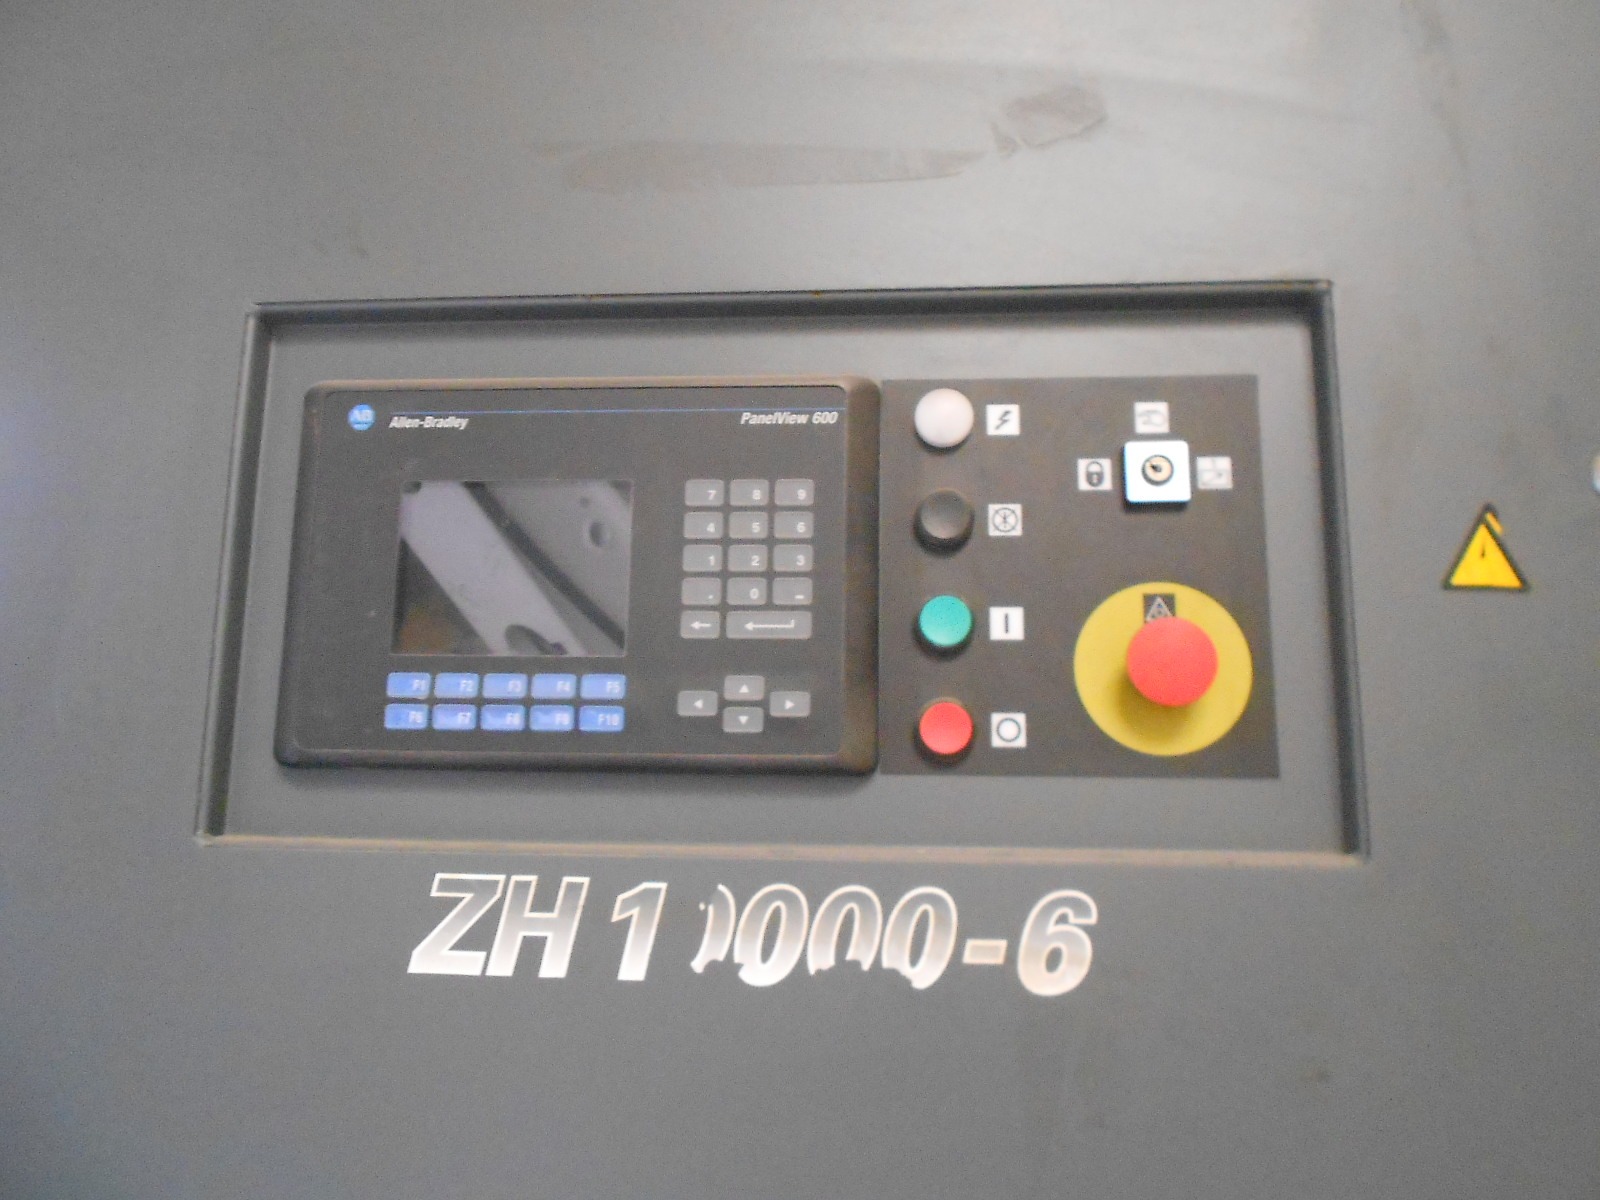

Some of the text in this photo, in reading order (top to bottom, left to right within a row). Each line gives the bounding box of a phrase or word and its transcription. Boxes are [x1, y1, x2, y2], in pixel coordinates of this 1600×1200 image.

[389, 416, 470, 430] Allen-Bradley
[740, 411, 839, 425] PanelView 600
[707, 490, 806, 500] 7 8 9
[706, 522, 806, 533] 4 5 6
[708, 555, 805, 566] 1 2 3
[749, 588, 759, 599] 0
[412, 679, 621, 693] F1 F2 F3 F4 F5
[457, 712, 470, 724] F7
[598, 713, 618, 726] F10
[407, 873, 590, 979] ZH
